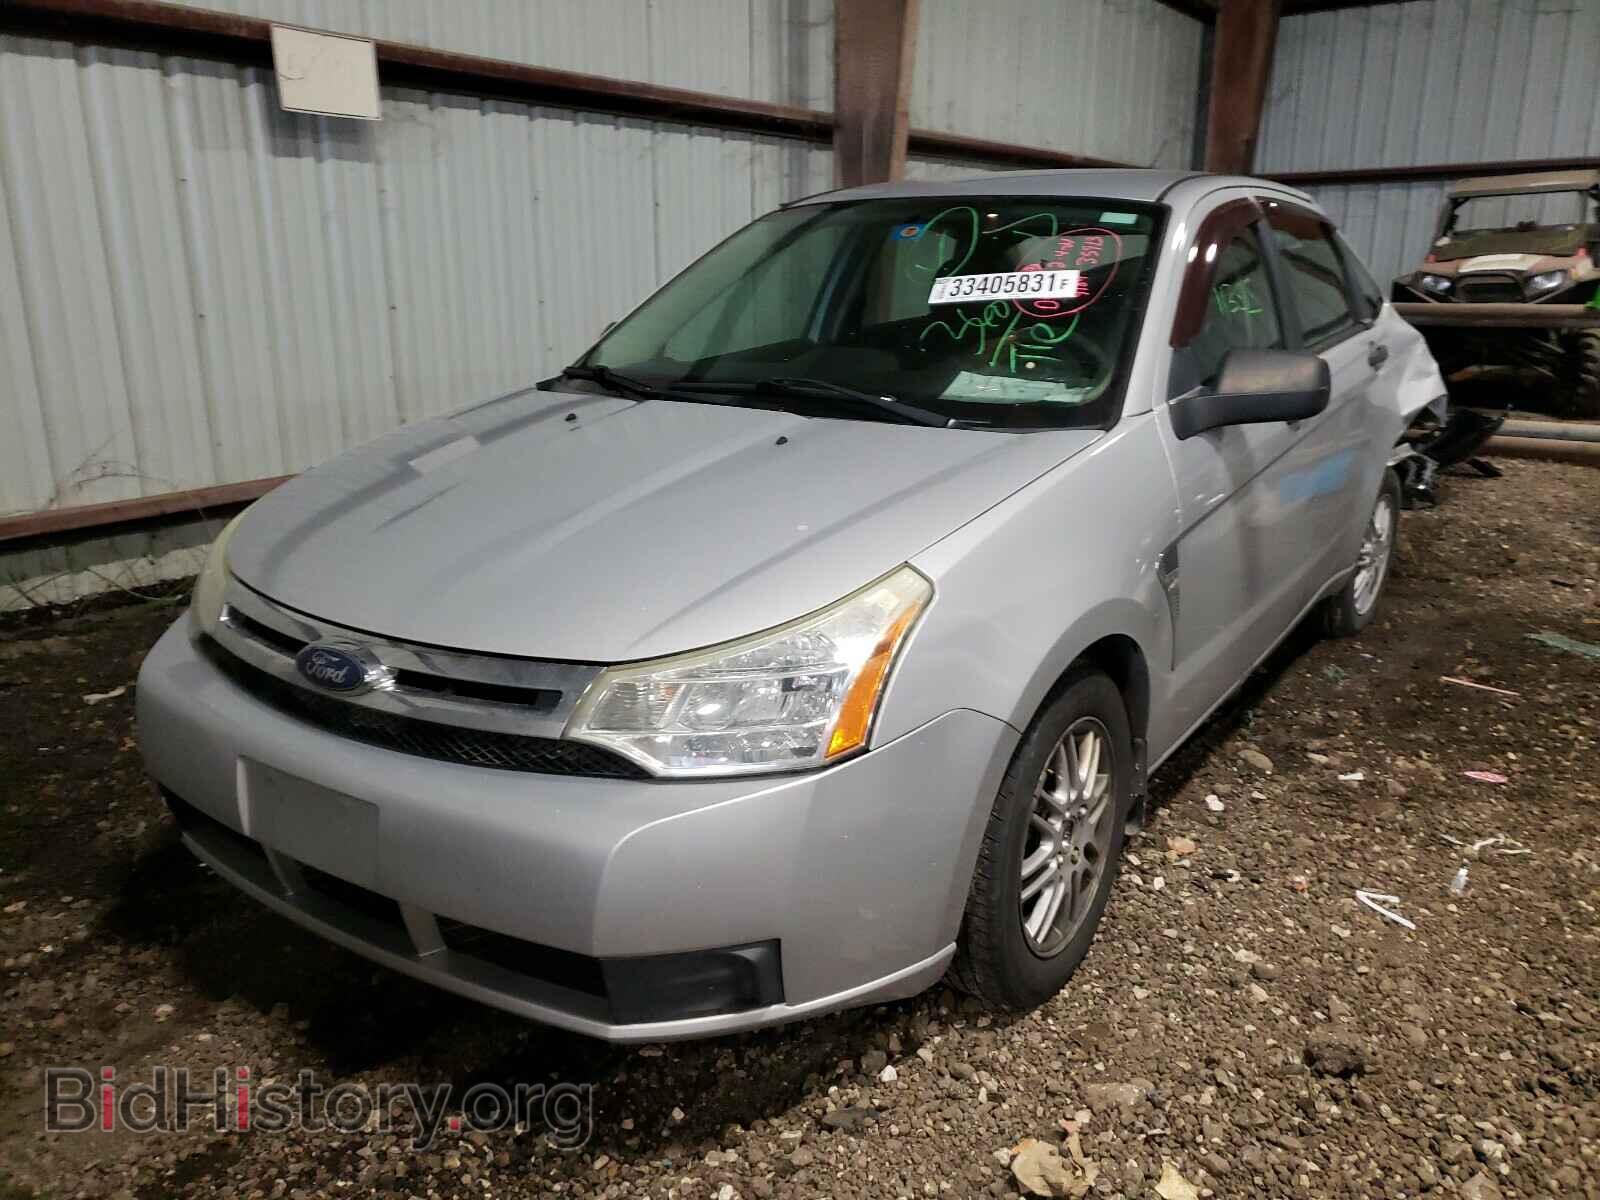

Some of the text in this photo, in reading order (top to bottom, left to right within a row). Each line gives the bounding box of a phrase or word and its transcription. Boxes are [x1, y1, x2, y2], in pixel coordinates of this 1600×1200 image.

[949, 273, 1057, 297] 33405831
[1059, 279, 1071, 290] F
[306, 651, 350, 684] Ford
